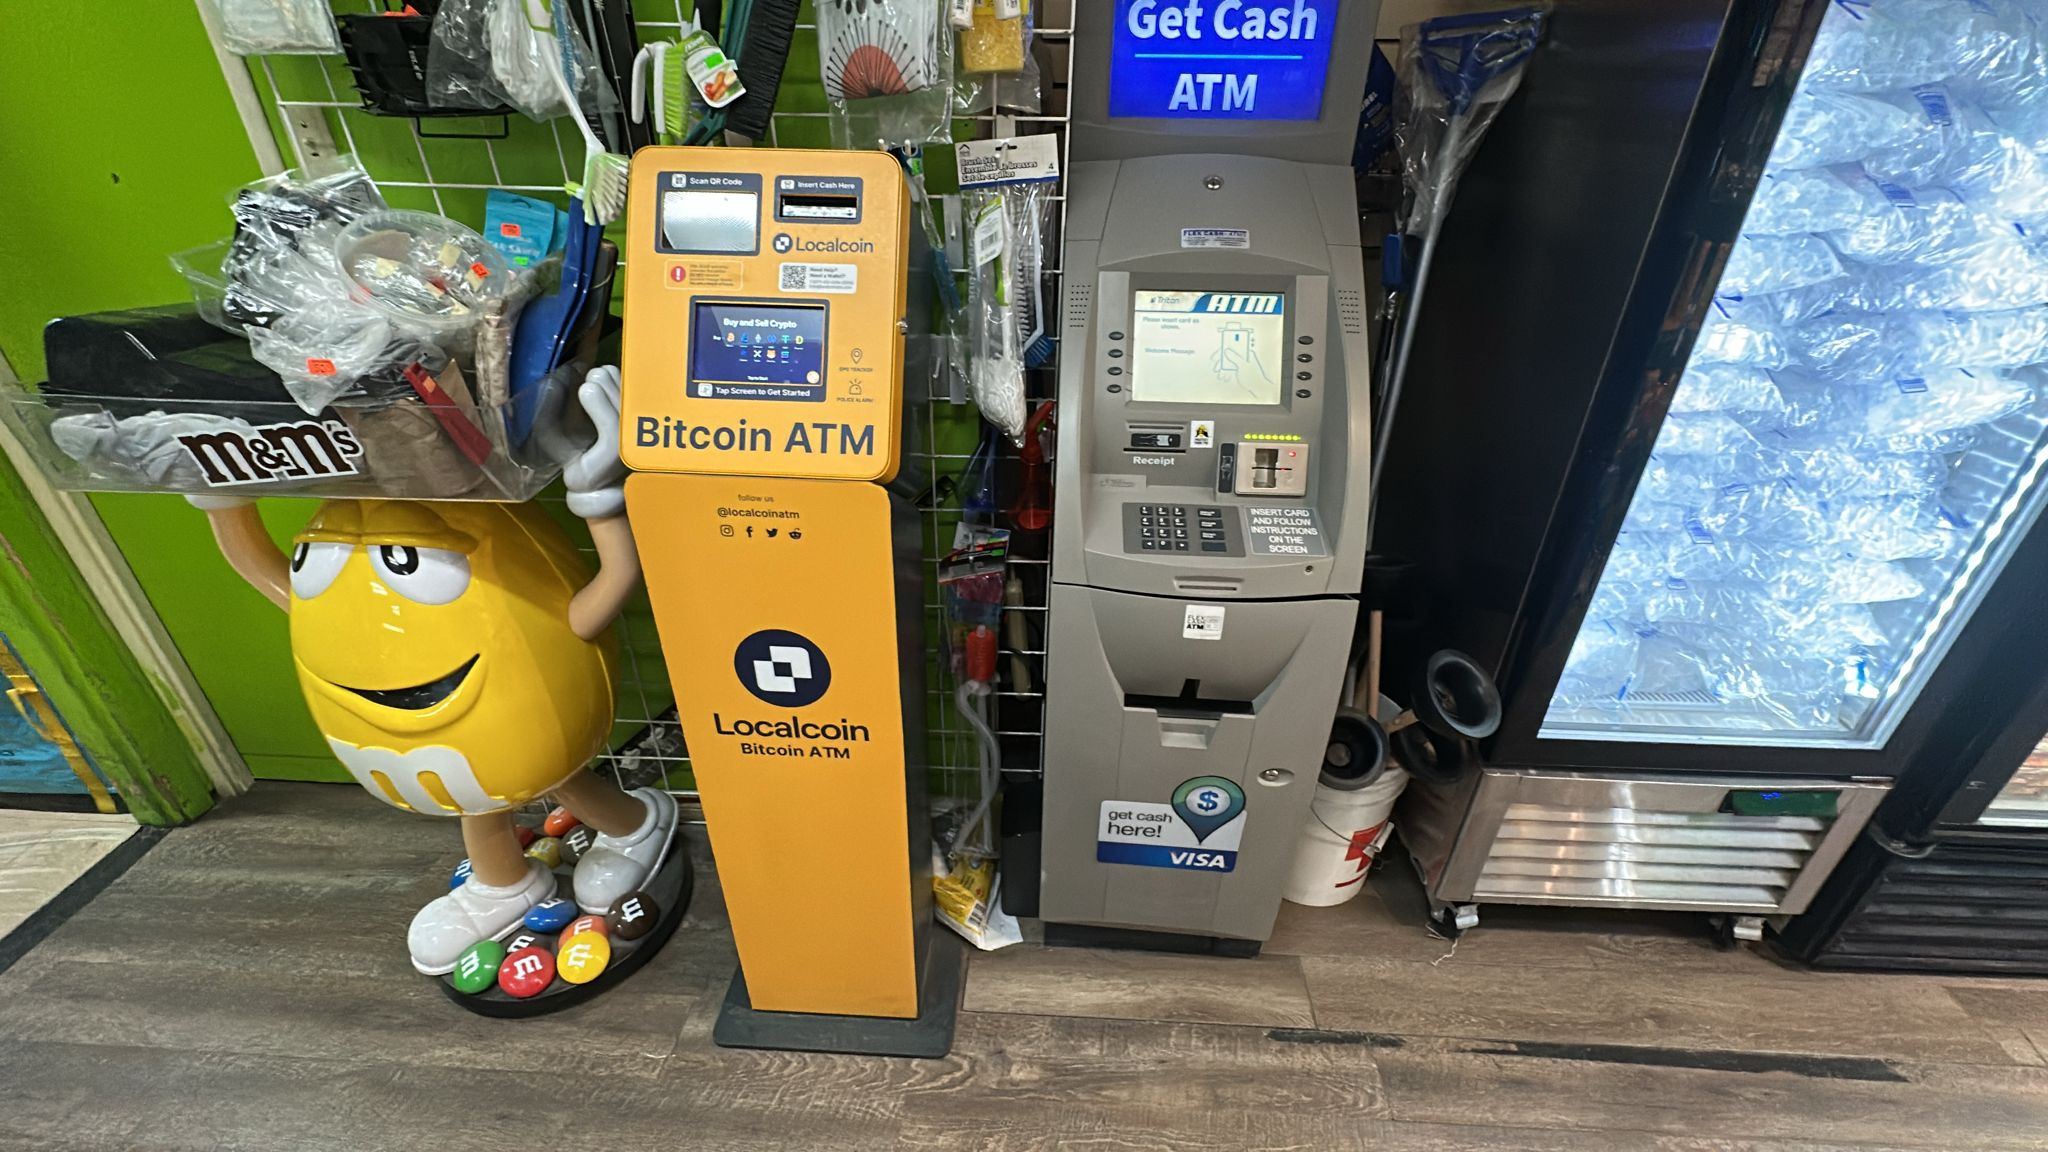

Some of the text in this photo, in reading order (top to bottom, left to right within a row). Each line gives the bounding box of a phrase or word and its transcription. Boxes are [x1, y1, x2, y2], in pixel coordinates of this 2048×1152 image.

[1128, 0, 1318, 40] Get Cash
[1168, 73, 1259, 112] ATM
[961, 162, 997, 174] Ensemble
[689, 177, 743, 186] Scan QR Code
[797, 181, 855, 190] Insert Cash Here
[796, 236, 874, 253] Localcoin
[1206, 295, 1279, 313] ATM
[723, 318, 798, 330] Buy and Sell Crypto
[715, 386, 811, 397] Tap Screen to Get Started
[636, 415, 874, 456] Bitcoin ATM
[1132, 456, 1175, 467] Receipt
[737, 494, 762, 502] follow
[717, 507, 800, 519] @localcoinatm
[1250, 508, 1310, 517] INSERT CARD
[1253, 517, 1311, 526] AND FOLLOW
[1250, 526, 1318, 535] INSTRUCTIONS
[1268, 535, 1304, 544] ON THE
[1268, 545, 1308, 554] SCREEN
[713, 712, 870, 742] Localcoin
[740, 743, 850, 759] Bitcoin ATM
[1108, 810, 1173, 824] get cash
[1107, 821, 1162, 838] here!
[1170, 851, 1226, 869] VISA
